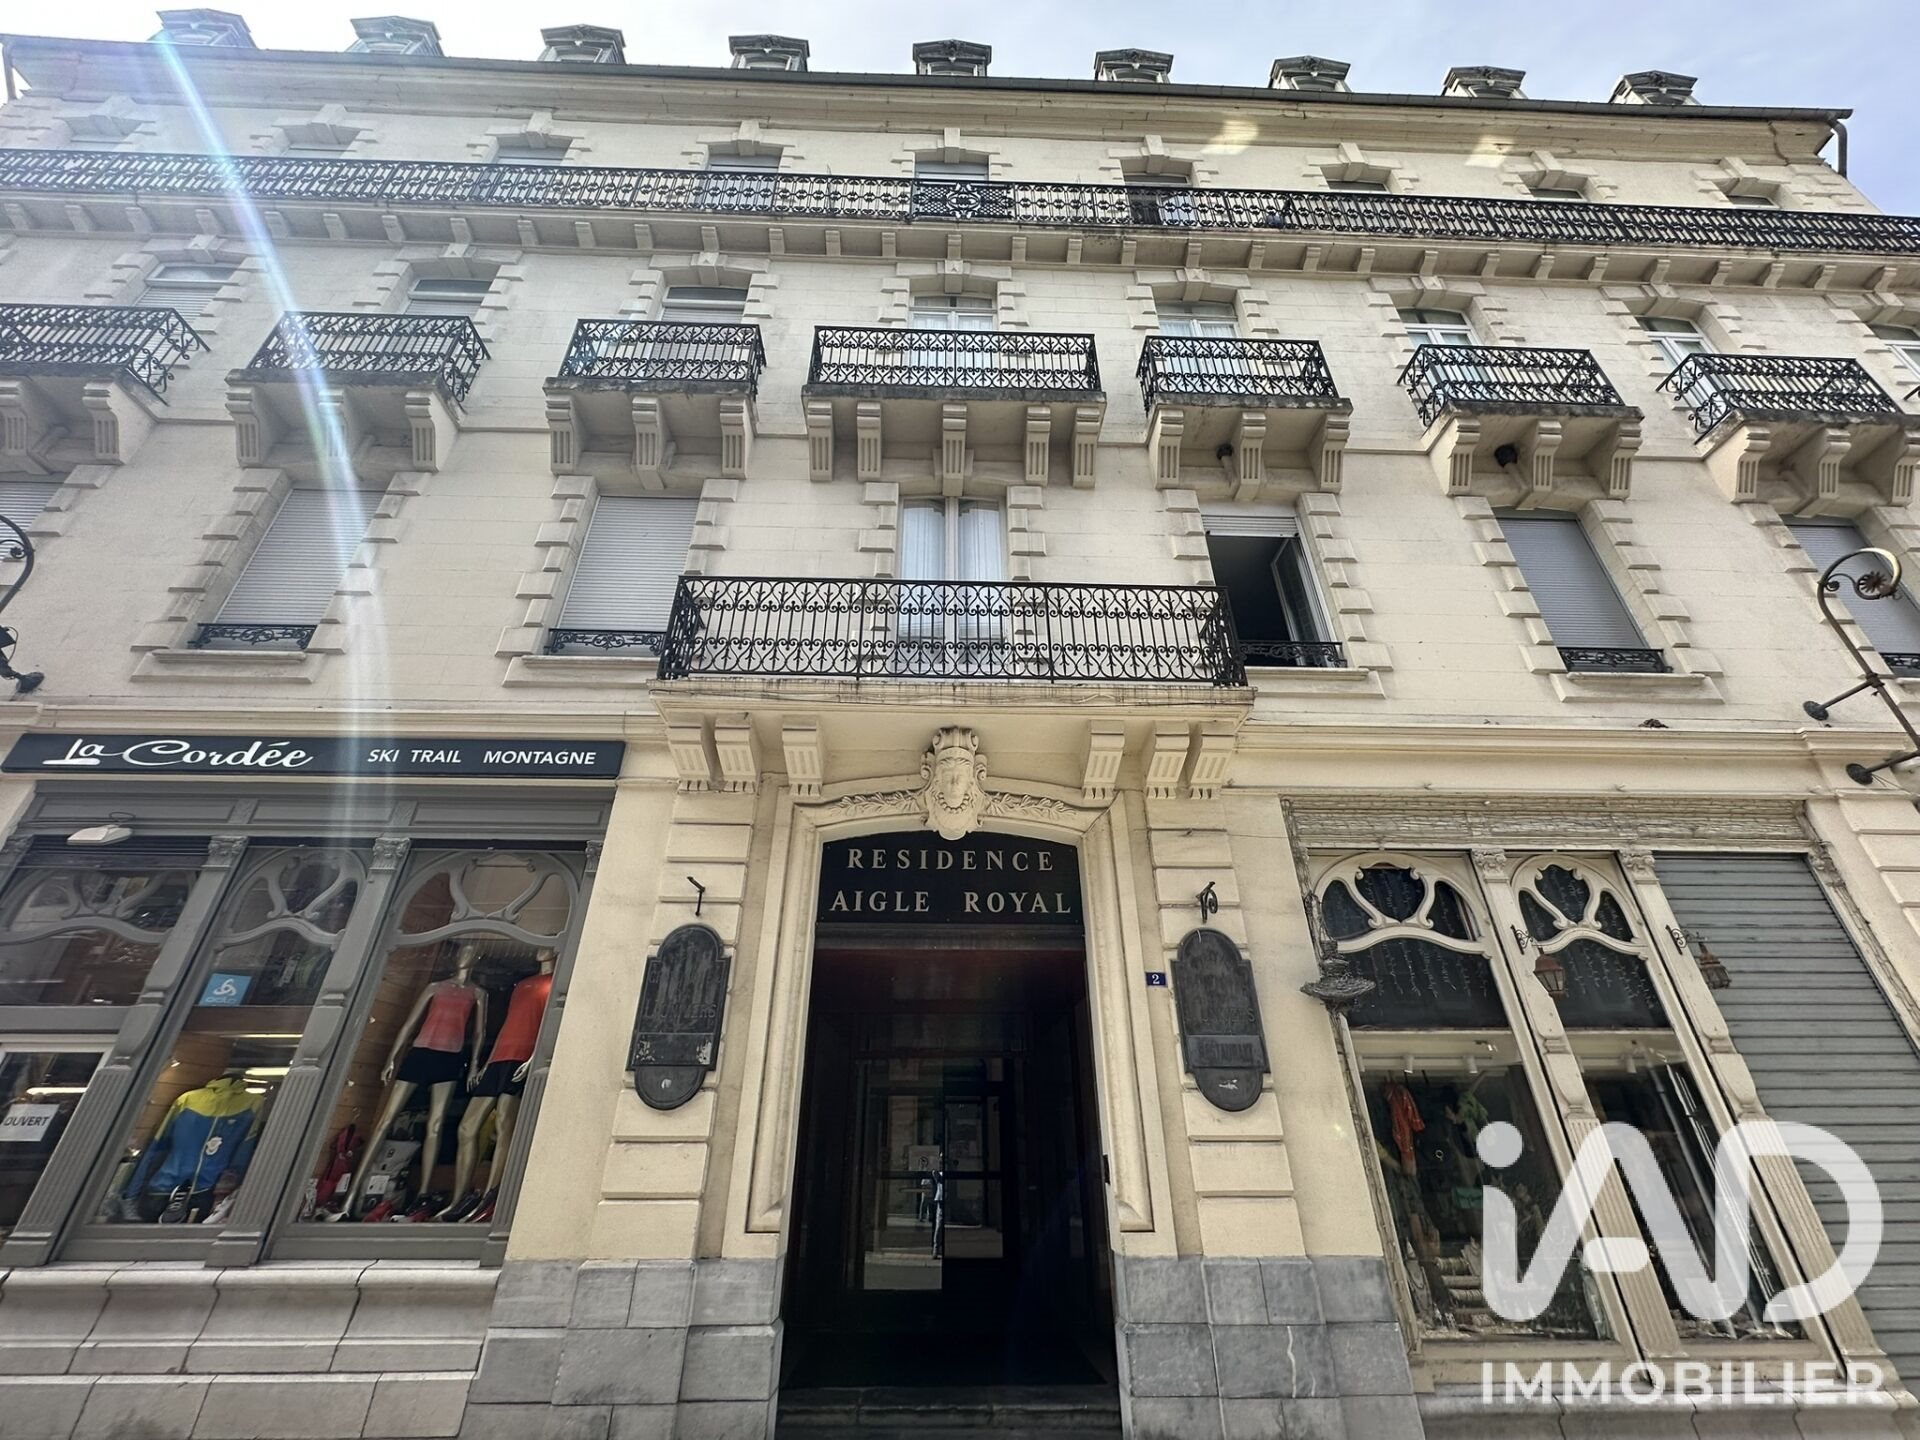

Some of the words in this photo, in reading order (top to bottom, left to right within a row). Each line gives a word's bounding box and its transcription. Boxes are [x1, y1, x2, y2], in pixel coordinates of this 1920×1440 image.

[42, 738, 104, 766] La
[122, 739, 314, 768] Cordée
[367, 749, 399, 763] SKI
[411, 749, 462, 764] TRAIL
[483, 750, 597, 766] MONTAGNE
[847, 848, 1053, 872] RESIDENCE
[829, 890, 930, 912] AIGLE
[963, 891, 1072, 914] ROYAL
[1151, 973, 1160, 985] 2
[3, 1116, 51, 1126] OUVERT
